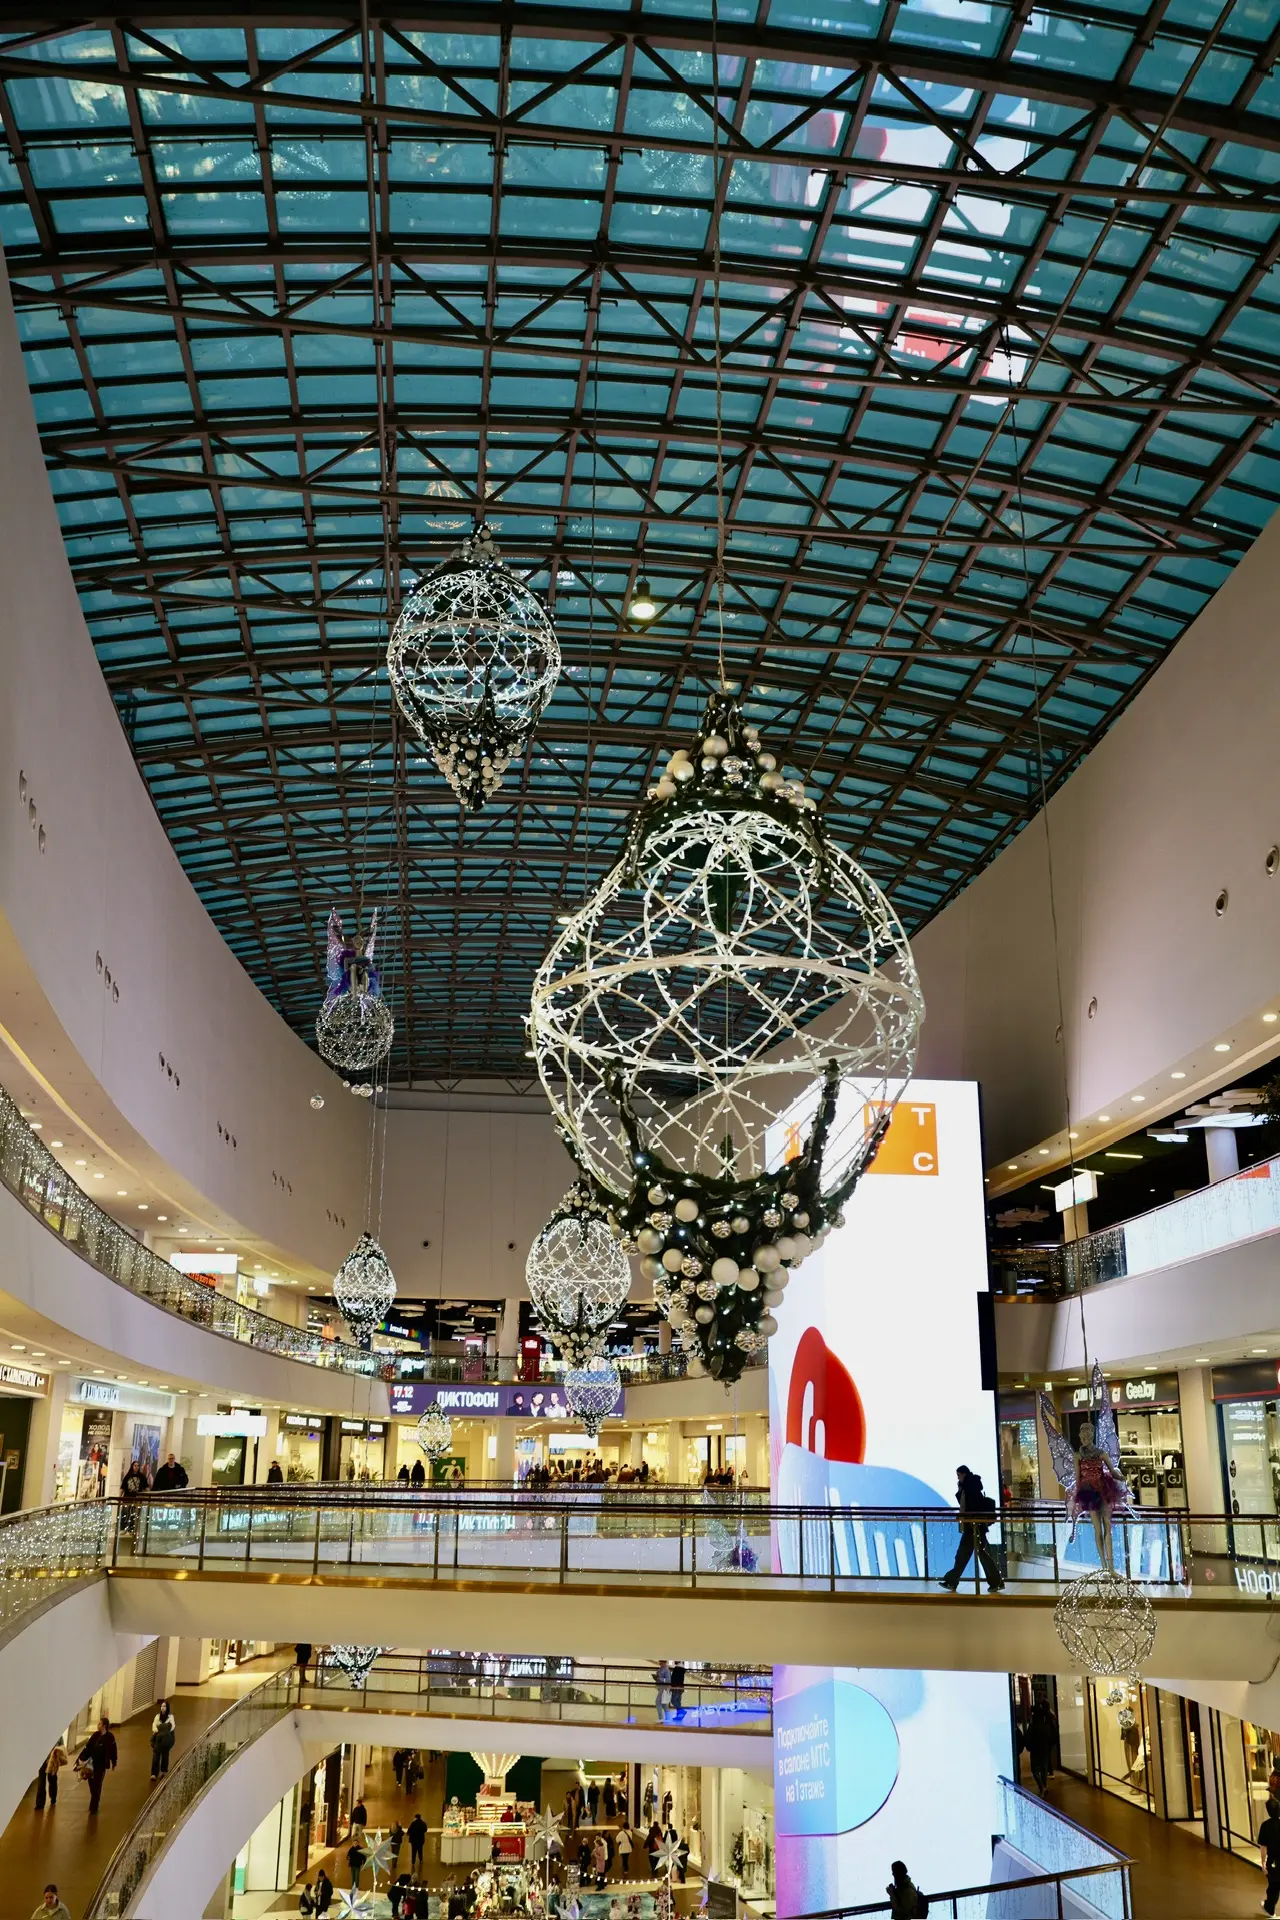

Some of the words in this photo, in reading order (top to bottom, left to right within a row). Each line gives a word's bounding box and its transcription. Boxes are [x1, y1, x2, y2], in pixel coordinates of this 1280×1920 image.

[393, 1385, 414, 1398] 17.12
[437, 1391, 499, 1408] ДИКТОФОН
[1125, 1380, 1156, 1401] GeeJay
[1141, 1474, 1155, 1485] GJ
[1167, 1473, 1182, 1485] GJ
[777, 1713, 829, 1750] Подключайте
[778, 1758, 784, 1776] в
[783, 1753, 810, 1776] салоне
[809, 1742, 831, 1771] МТС
[785, 1783, 796, 1803] на
[795, 1780, 800, 1802] 1
[799, 1780, 825, 1801] этаже
